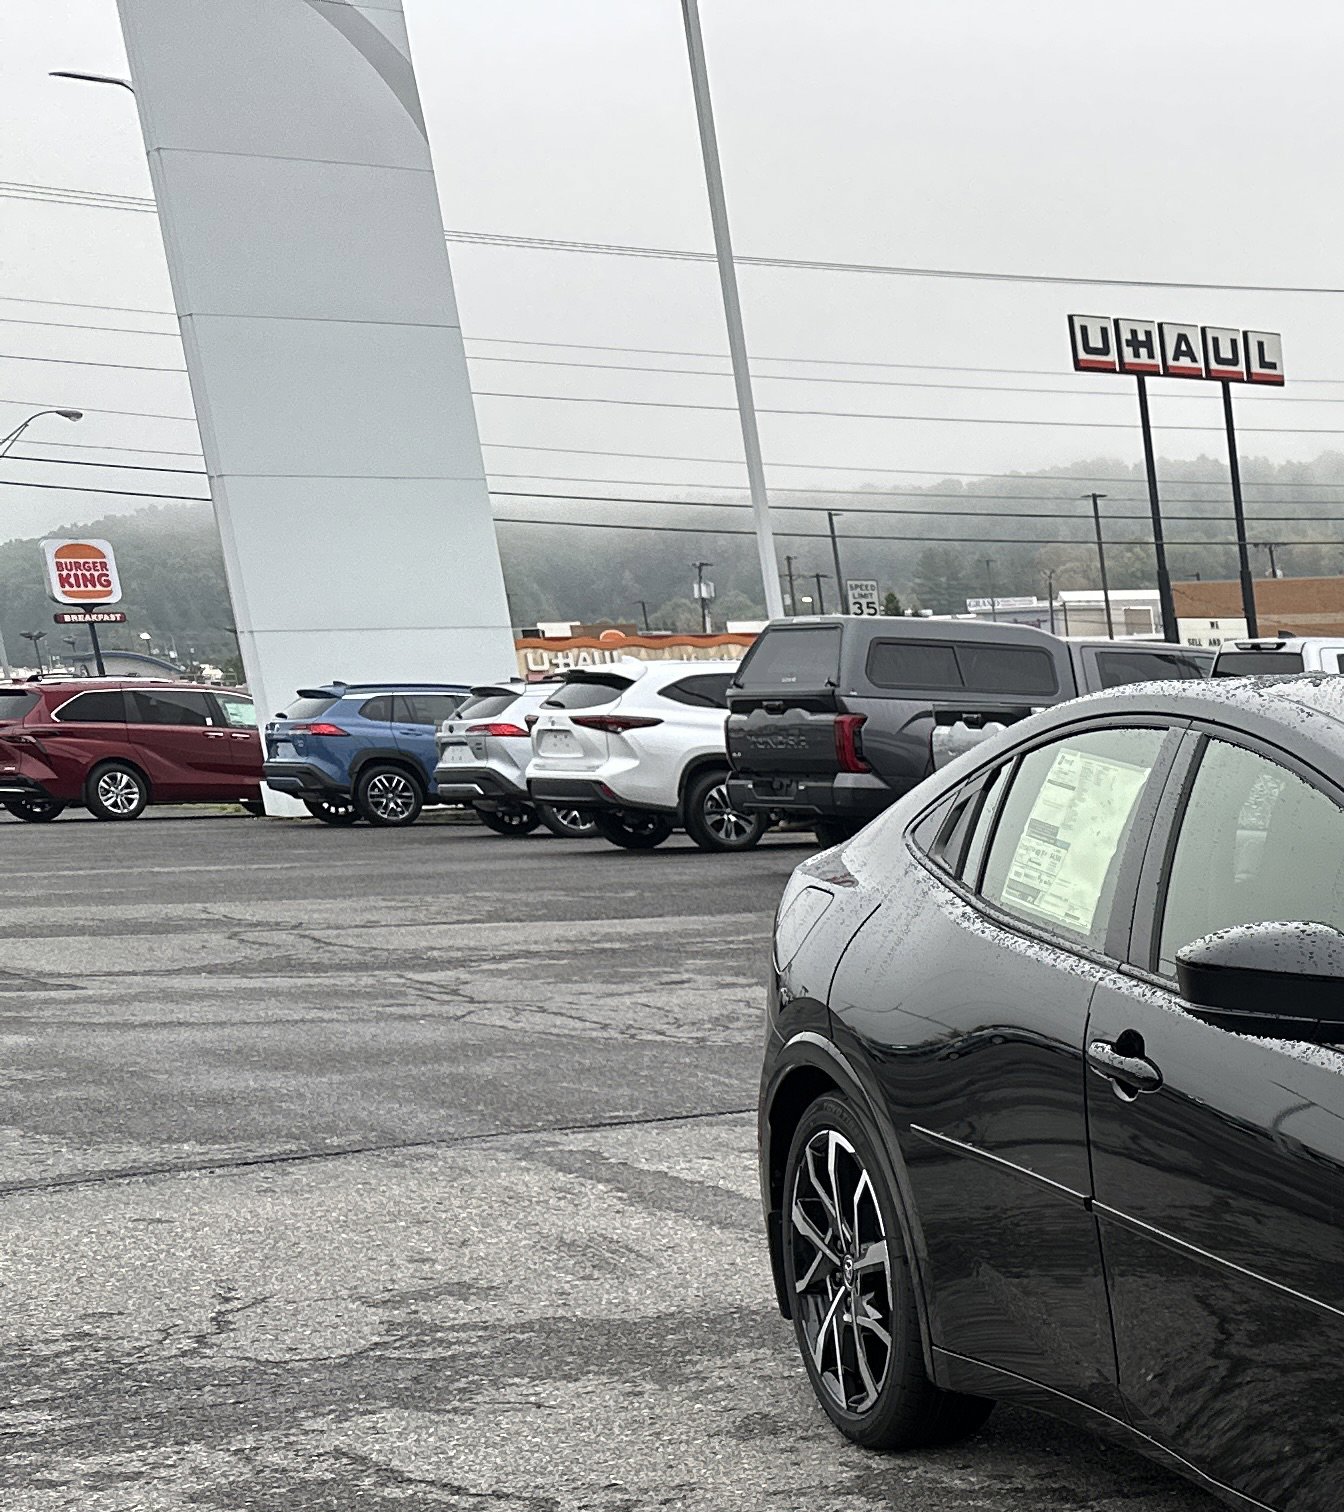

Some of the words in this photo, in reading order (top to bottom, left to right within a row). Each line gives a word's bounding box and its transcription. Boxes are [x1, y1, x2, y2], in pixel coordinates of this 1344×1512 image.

[55, 560, 109, 573] BURGER
[58, 572, 112, 589] KING
[849, 583, 876, 592] SPEED
[852, 592, 874, 600] LIMIT
[852, 601, 878, 616] 35
[63, 613, 122, 622] BREAKFAST
